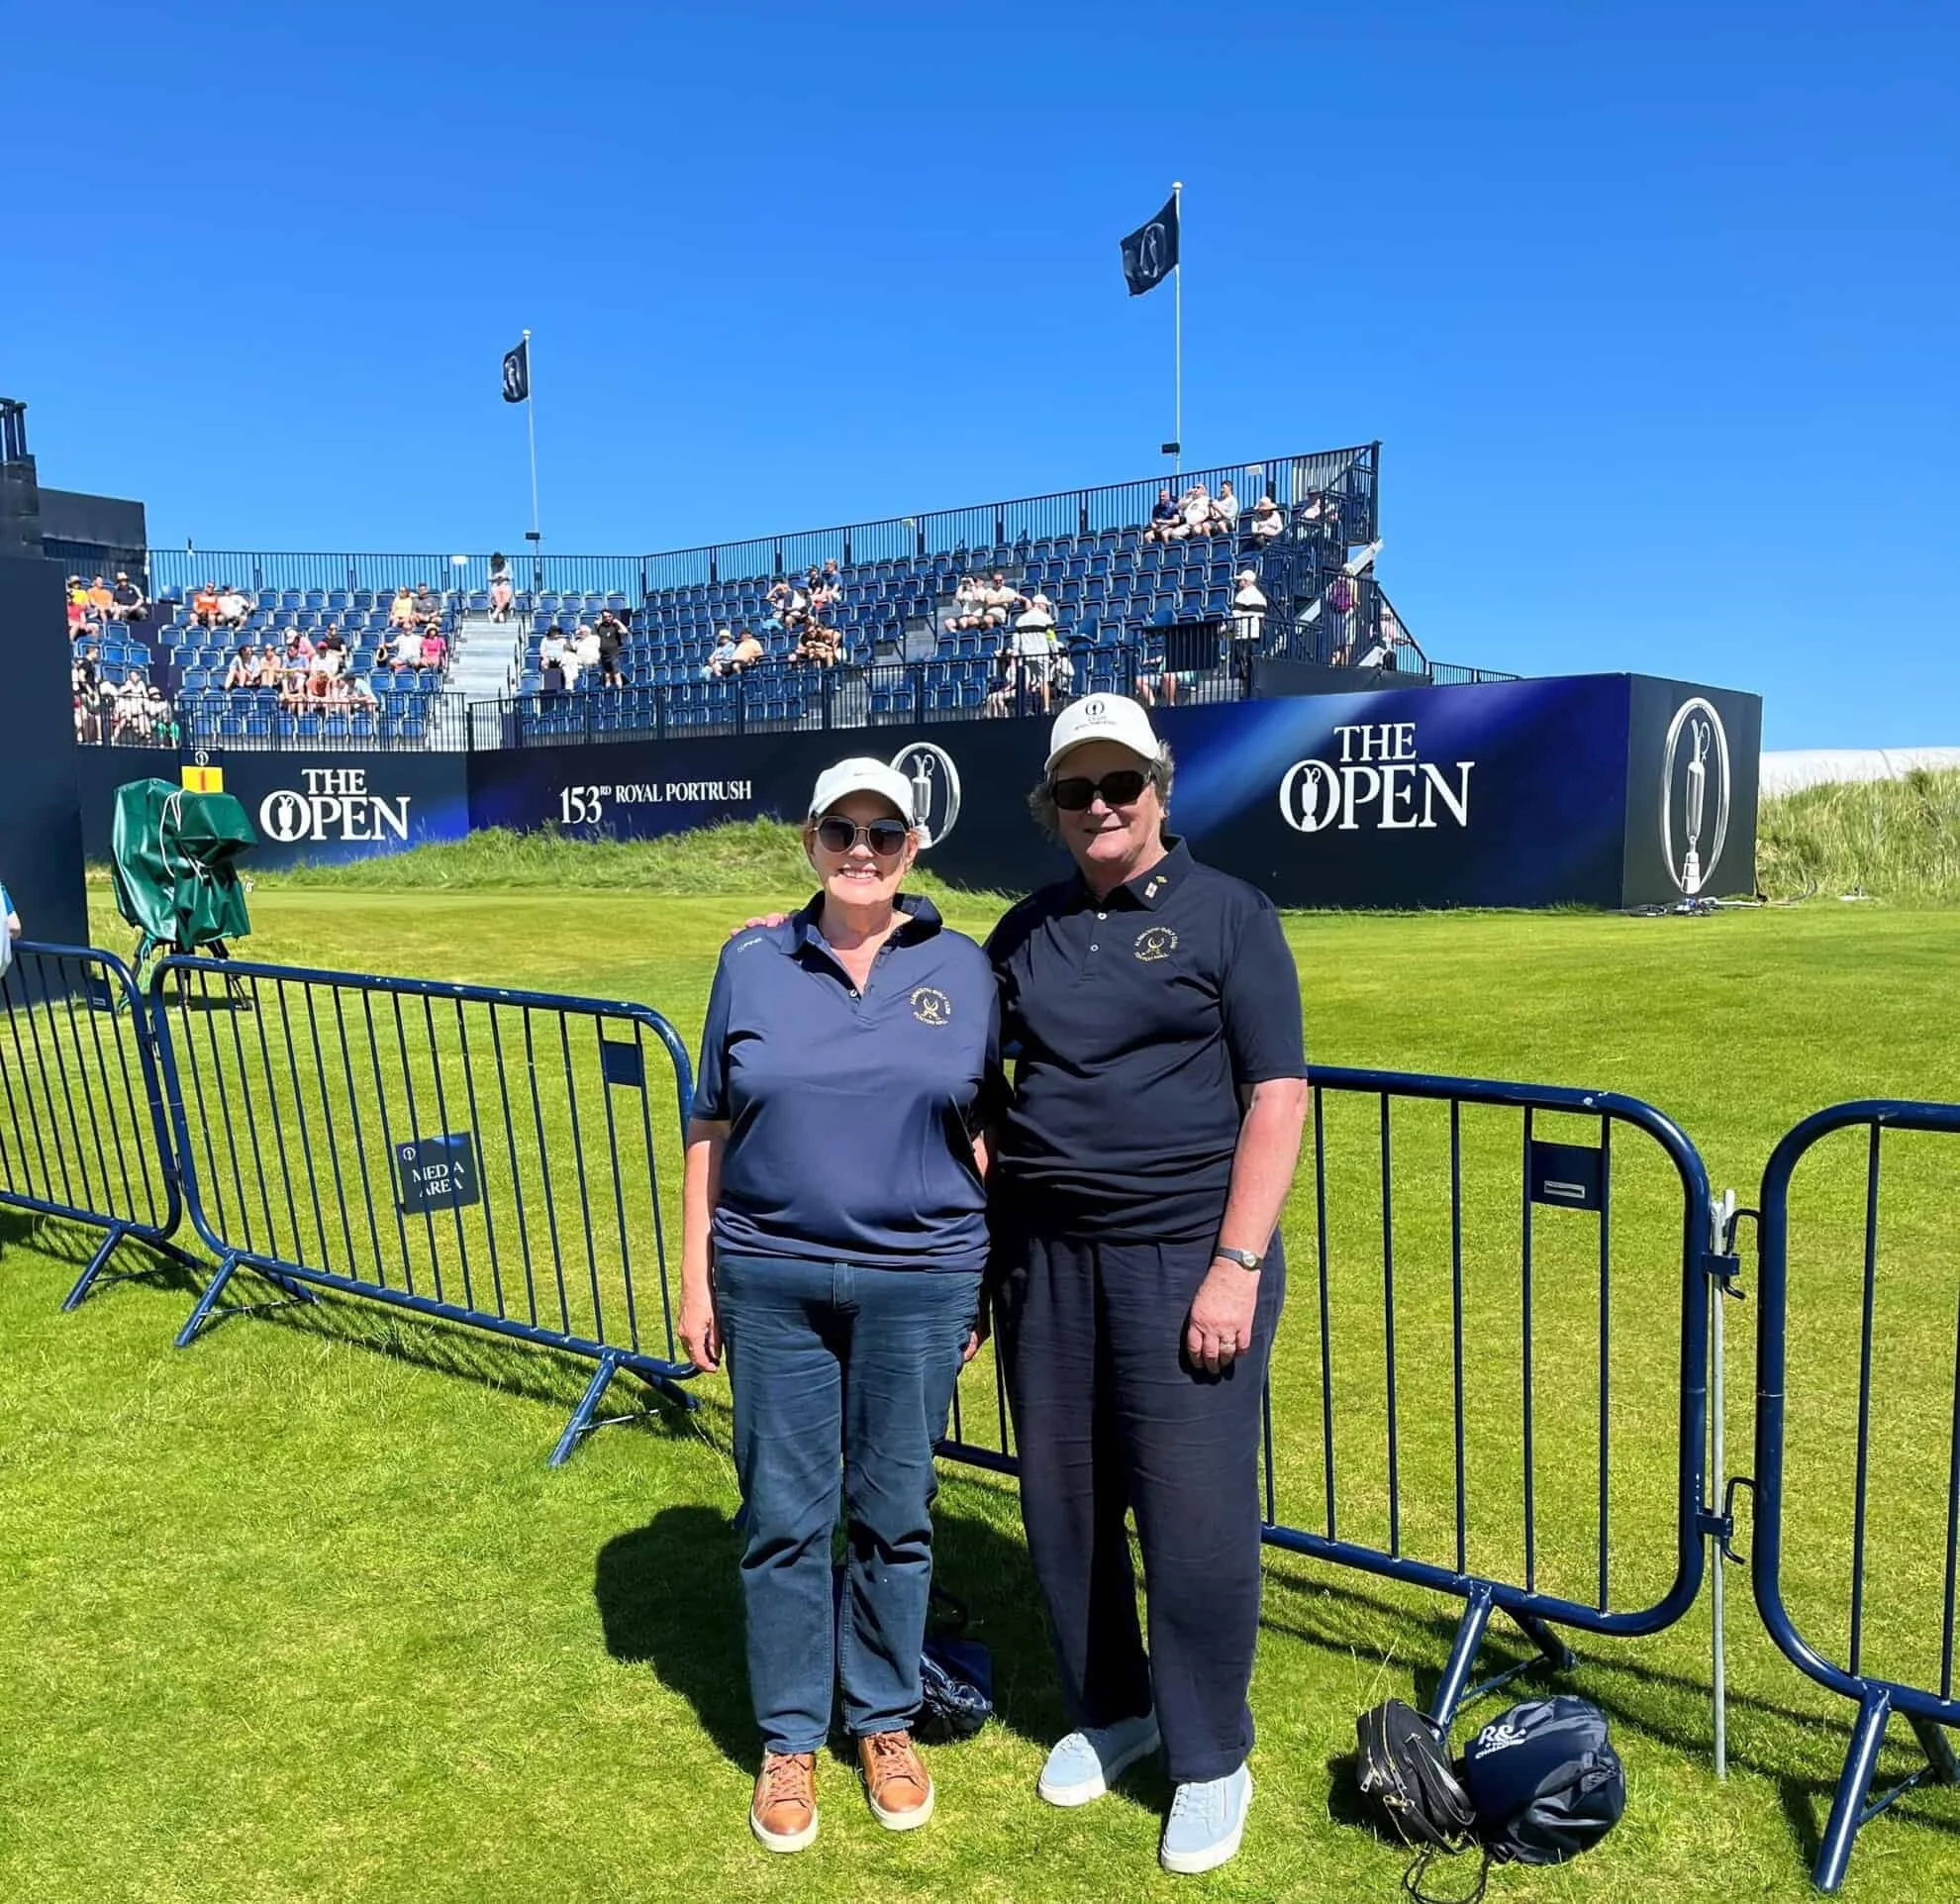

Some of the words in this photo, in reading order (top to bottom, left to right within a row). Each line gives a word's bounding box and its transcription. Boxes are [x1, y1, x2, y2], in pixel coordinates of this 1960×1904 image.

[1333, 723, 1417, 761] THE
[301, 768, 367, 795] THE
[615, 783, 662, 803] ROYAL
[665, 780, 751, 801] PORTRUSH
[1279, 758, 1475, 832] OPEN
[259, 789, 411, 842] OPEN
[412, 1160, 464, 1183] MEDA
